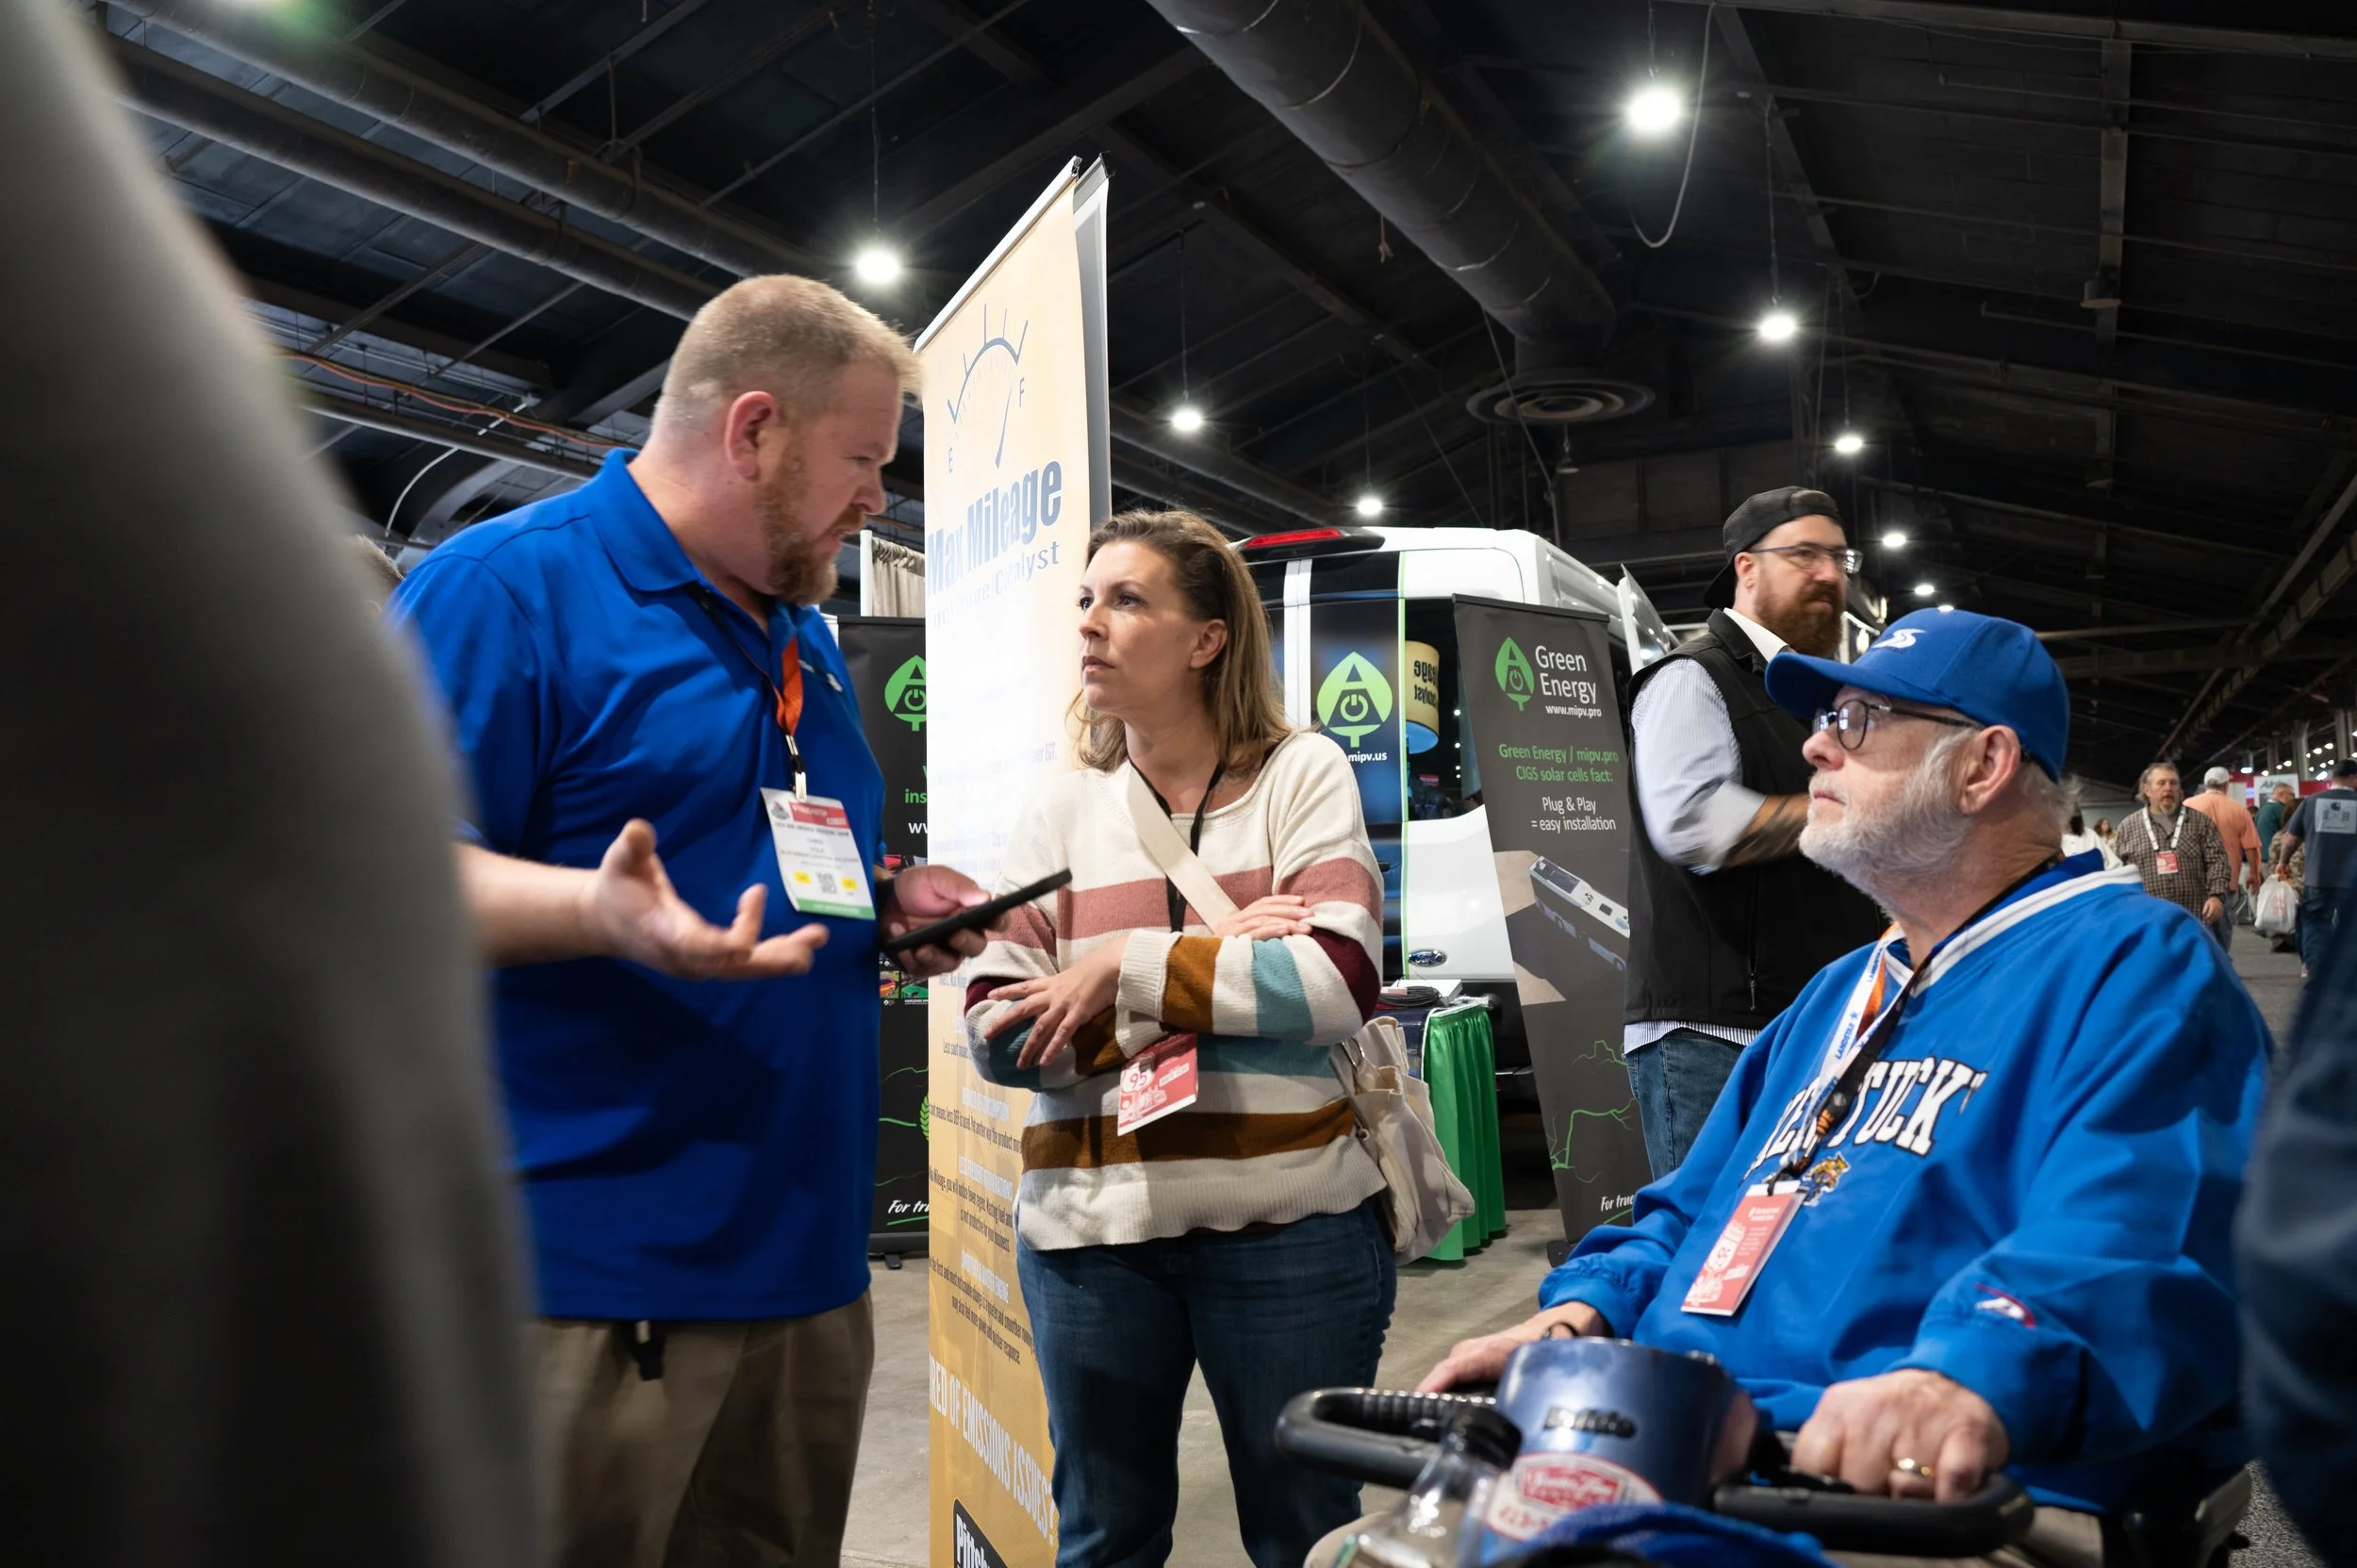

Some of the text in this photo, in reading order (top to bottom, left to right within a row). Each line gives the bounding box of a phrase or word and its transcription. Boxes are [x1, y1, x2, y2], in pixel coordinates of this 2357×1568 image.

[967, 460, 1062, 573] Mileage
[1535, 645, 1587, 672] Green
[1540, 672, 1597, 704] Energy
[1545, 703, 1602, 718] www.mipv.pro
[1499, 743, 1531, 760] Green
[1532, 745, 1567, 764] Energy
[1576, 747, 1619, 764] mipv.pro
[1516, 766, 1614, 783] CIGS solar cells fact:
[1541, 797, 1597, 815] Plug & Play
[1540, 817, 1561, 834] easy
[1563, 816, 1617, 831] installation
[888, 1199, 911, 1213] For
[1601, 1196, 1614, 1212] For
[949, 1371, 961, 1430] OF
[962, 1384, 1011, 1492] EMISSIONS
